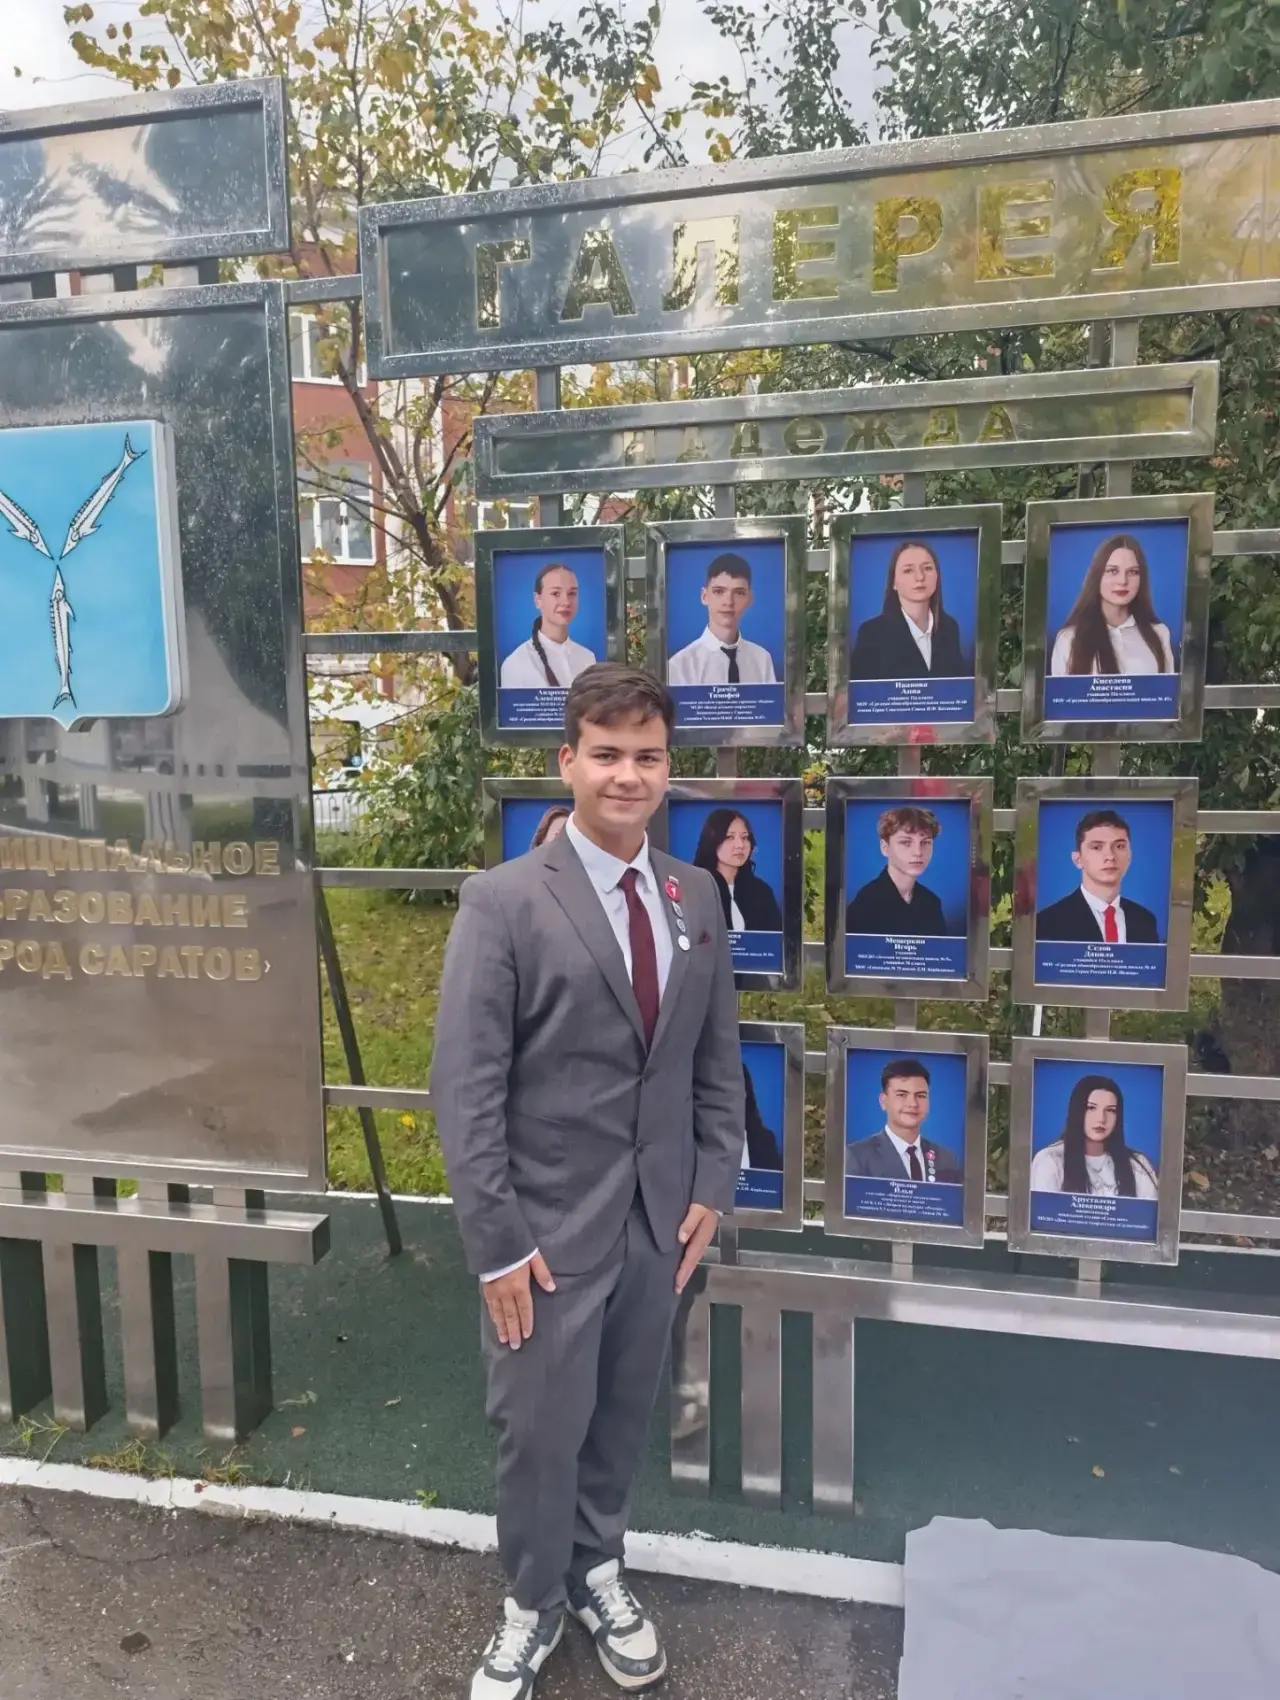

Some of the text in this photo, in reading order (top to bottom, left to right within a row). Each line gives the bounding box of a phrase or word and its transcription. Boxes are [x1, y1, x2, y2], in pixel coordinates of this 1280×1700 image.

[475, 167, 1183, 330] ГАЛЕРЕЯ
[0, 888, 248, 927] РАЗОВАНИЕ
[894, 943, 917, 952] Игорь
